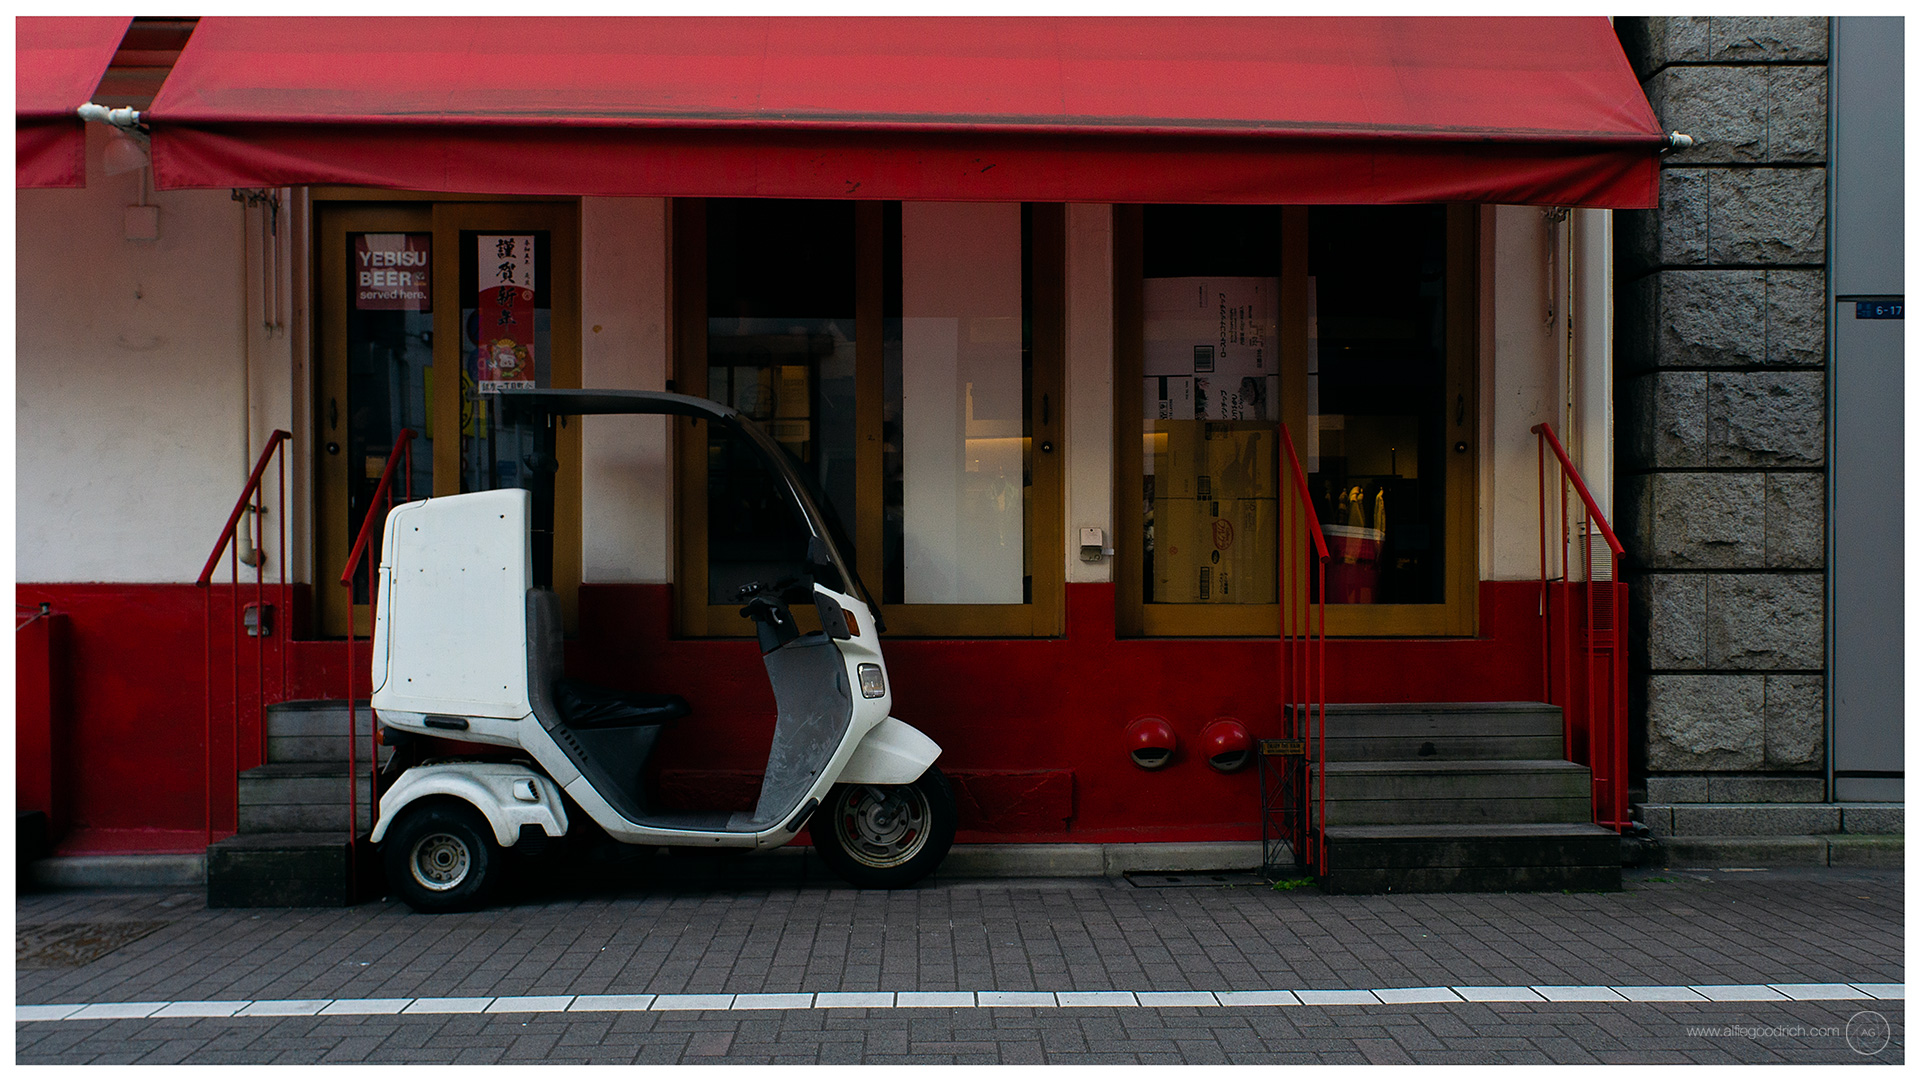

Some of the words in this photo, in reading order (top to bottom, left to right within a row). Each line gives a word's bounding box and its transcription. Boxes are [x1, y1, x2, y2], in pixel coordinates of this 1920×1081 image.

[359, 251, 427, 267] YEBISU
[360, 271, 412, 287] BEER
[496, 238, 517, 327] 謹賀新年
[360, 289, 397, 299] served
[399, 289, 427, 299] here.
[1876, 305, 1902, 316] 6-17
